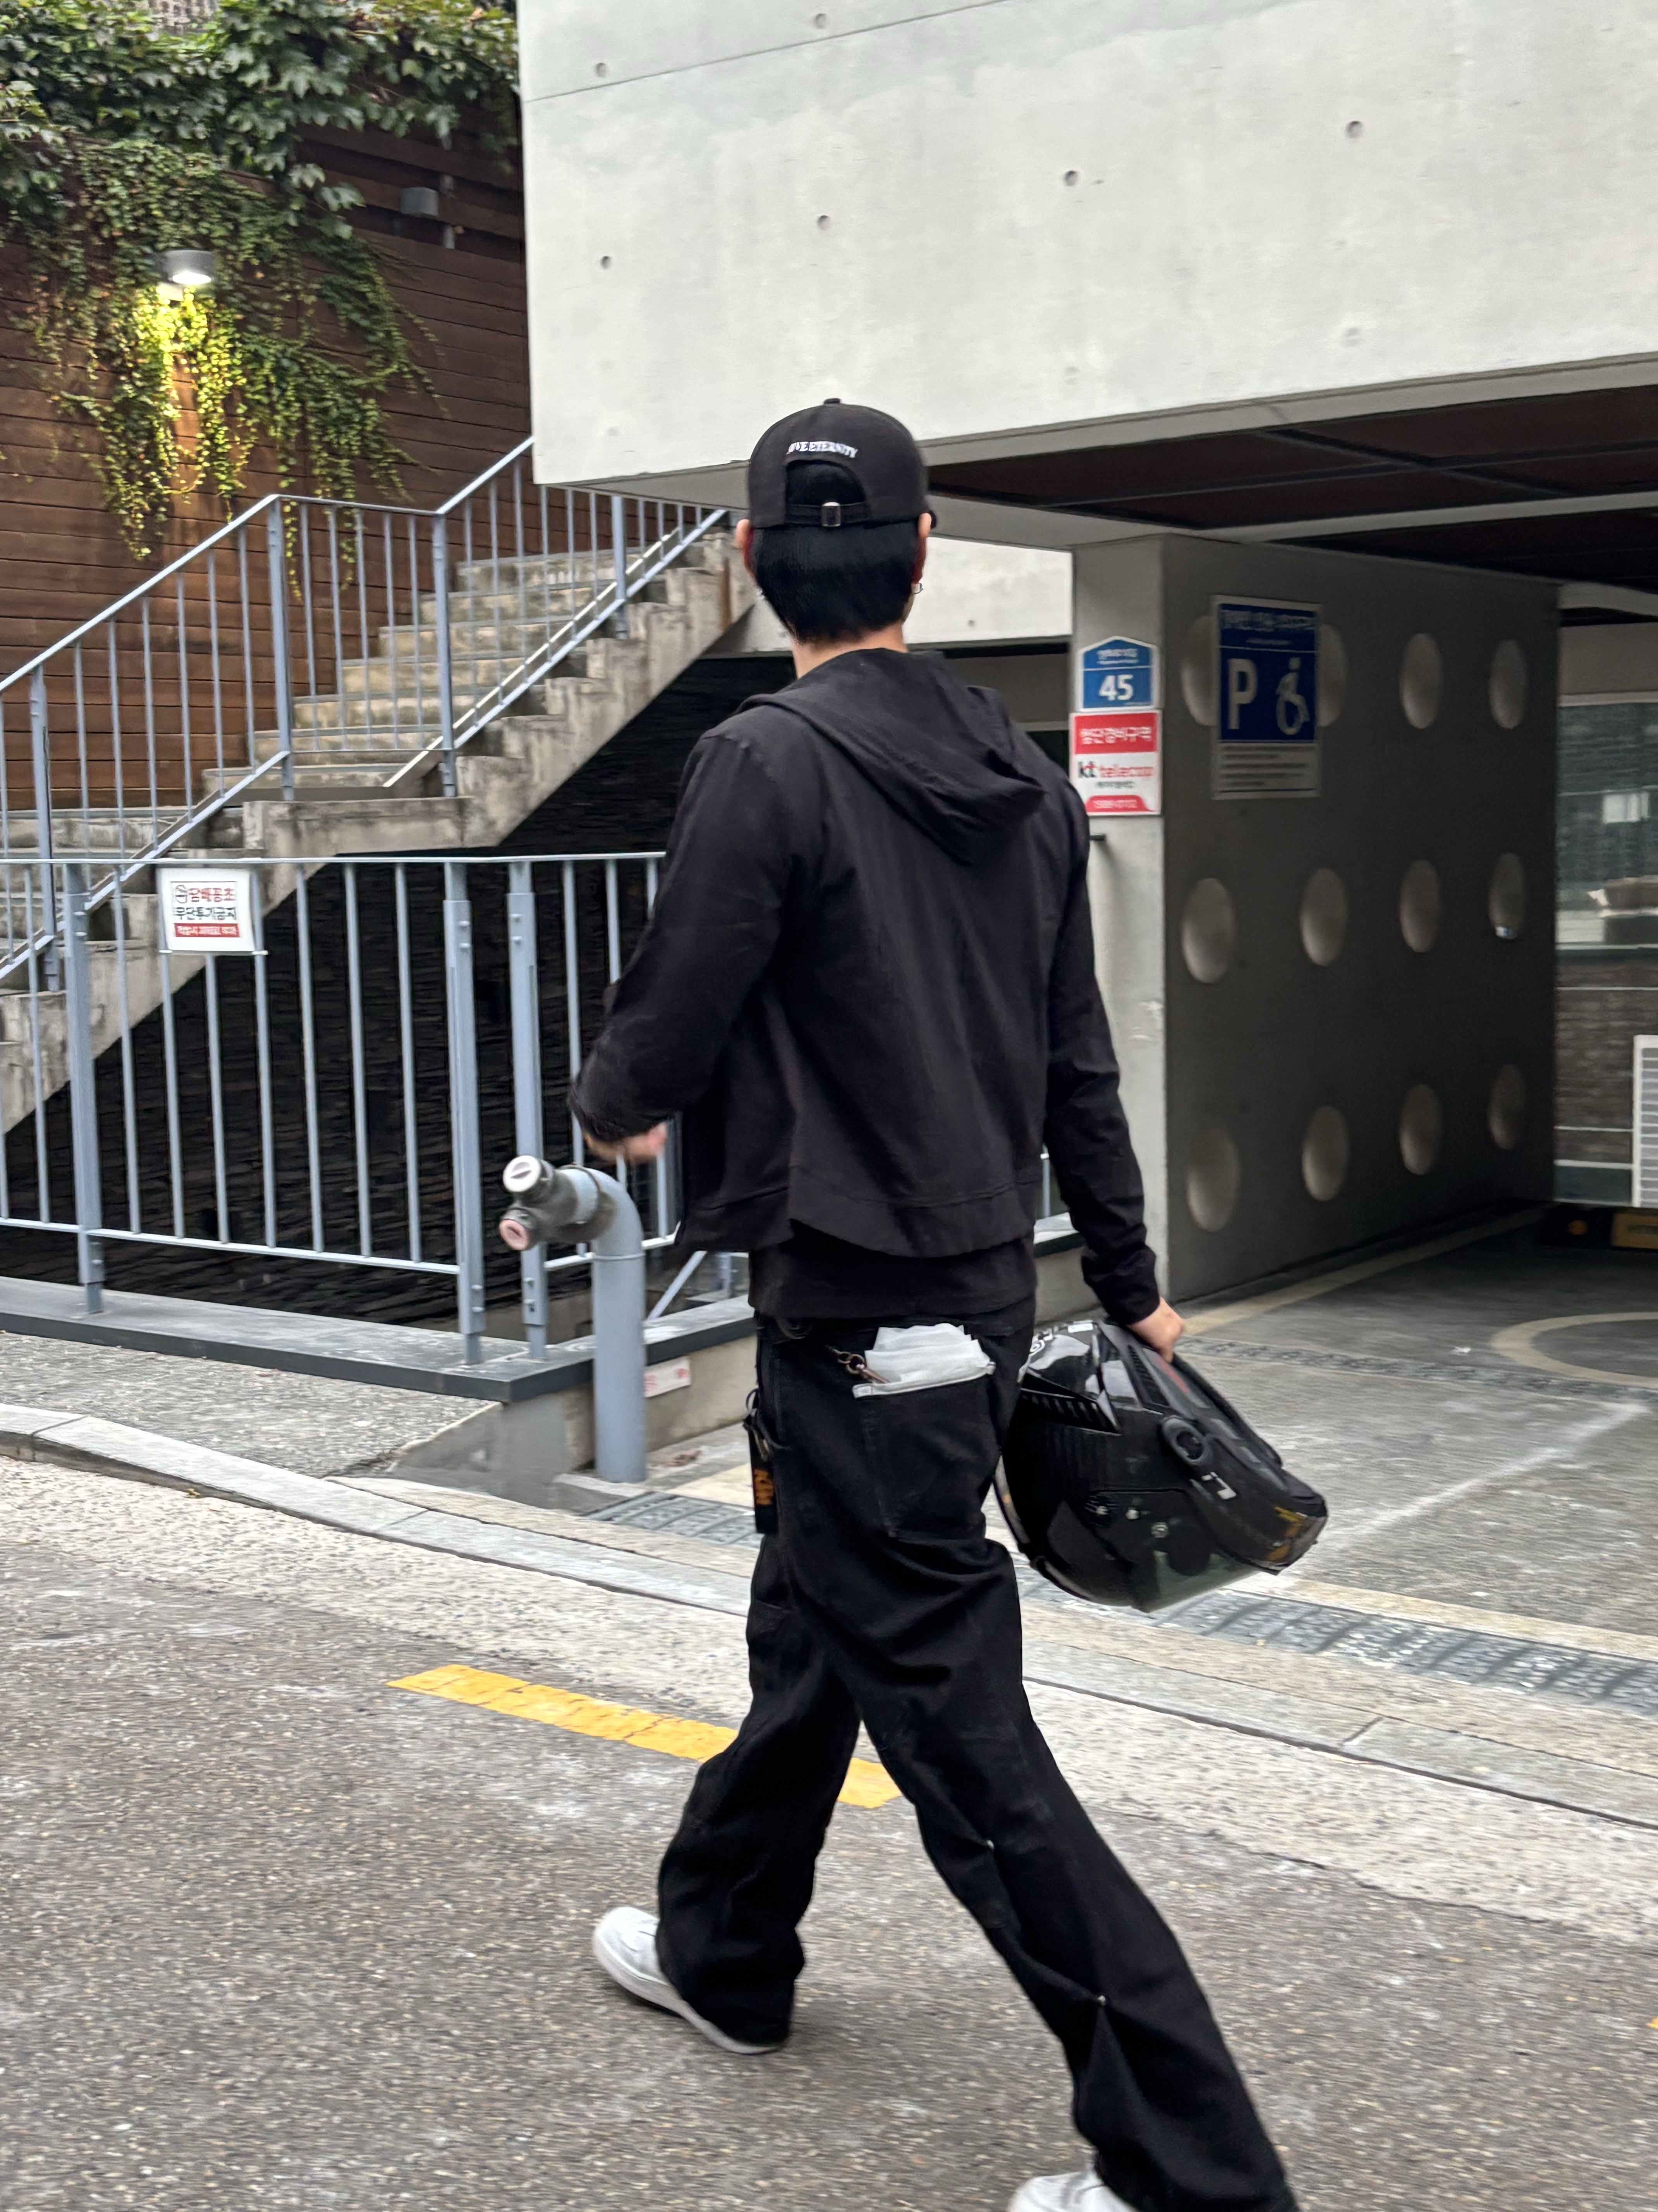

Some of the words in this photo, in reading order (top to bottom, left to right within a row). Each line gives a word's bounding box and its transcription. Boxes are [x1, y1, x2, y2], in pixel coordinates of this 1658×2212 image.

[1099, 674, 1133, 701] 45
[1228, 658, 1258, 730] P
[1078, 761, 1097, 778] kt
